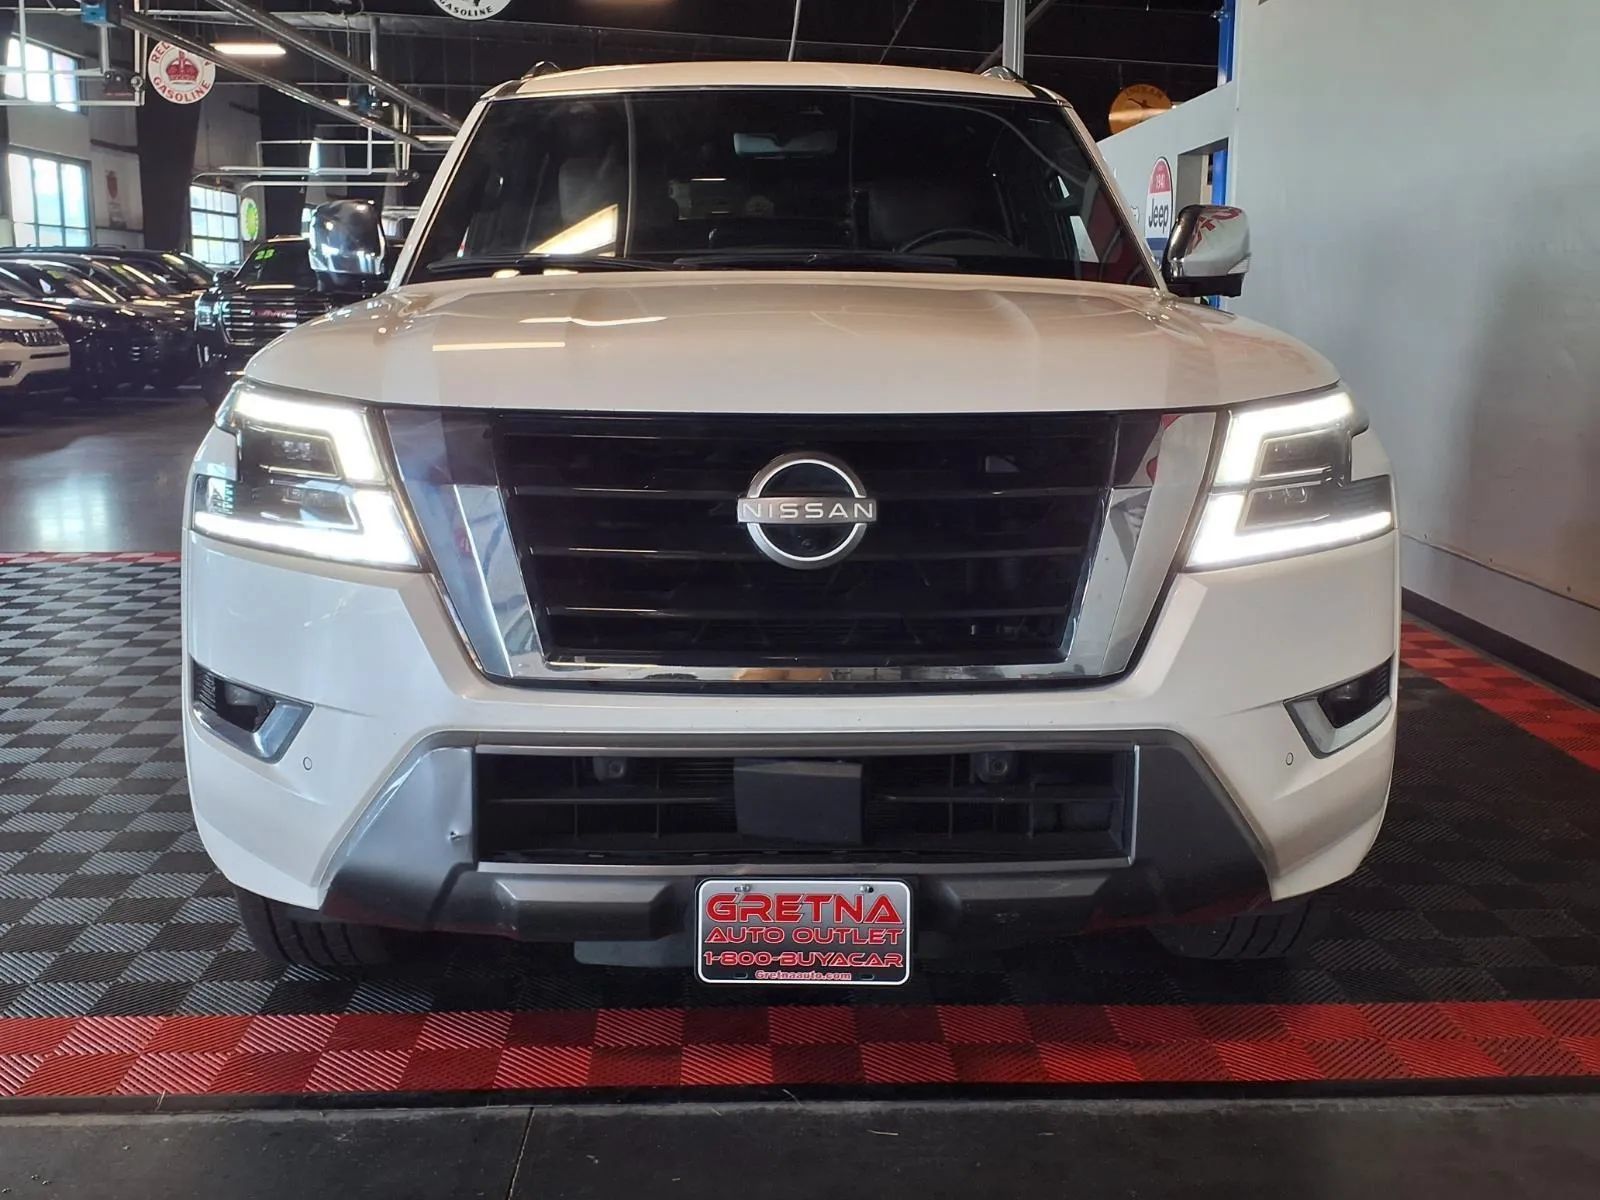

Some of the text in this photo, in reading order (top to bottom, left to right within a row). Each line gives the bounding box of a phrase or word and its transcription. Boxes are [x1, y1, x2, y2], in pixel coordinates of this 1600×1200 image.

[153, 76, 211, 102] GASOLINE
[1148, 199, 1169, 233] Jeep
[742, 502, 873, 519] NISSAN
[706, 893, 904, 925] GRETNA
[704, 926, 904, 945] AUTO OUTLET
[703, 951, 904, 968] 1-800-BUYACAR
[755, 969, 852, 981] Gretnaauto.com
